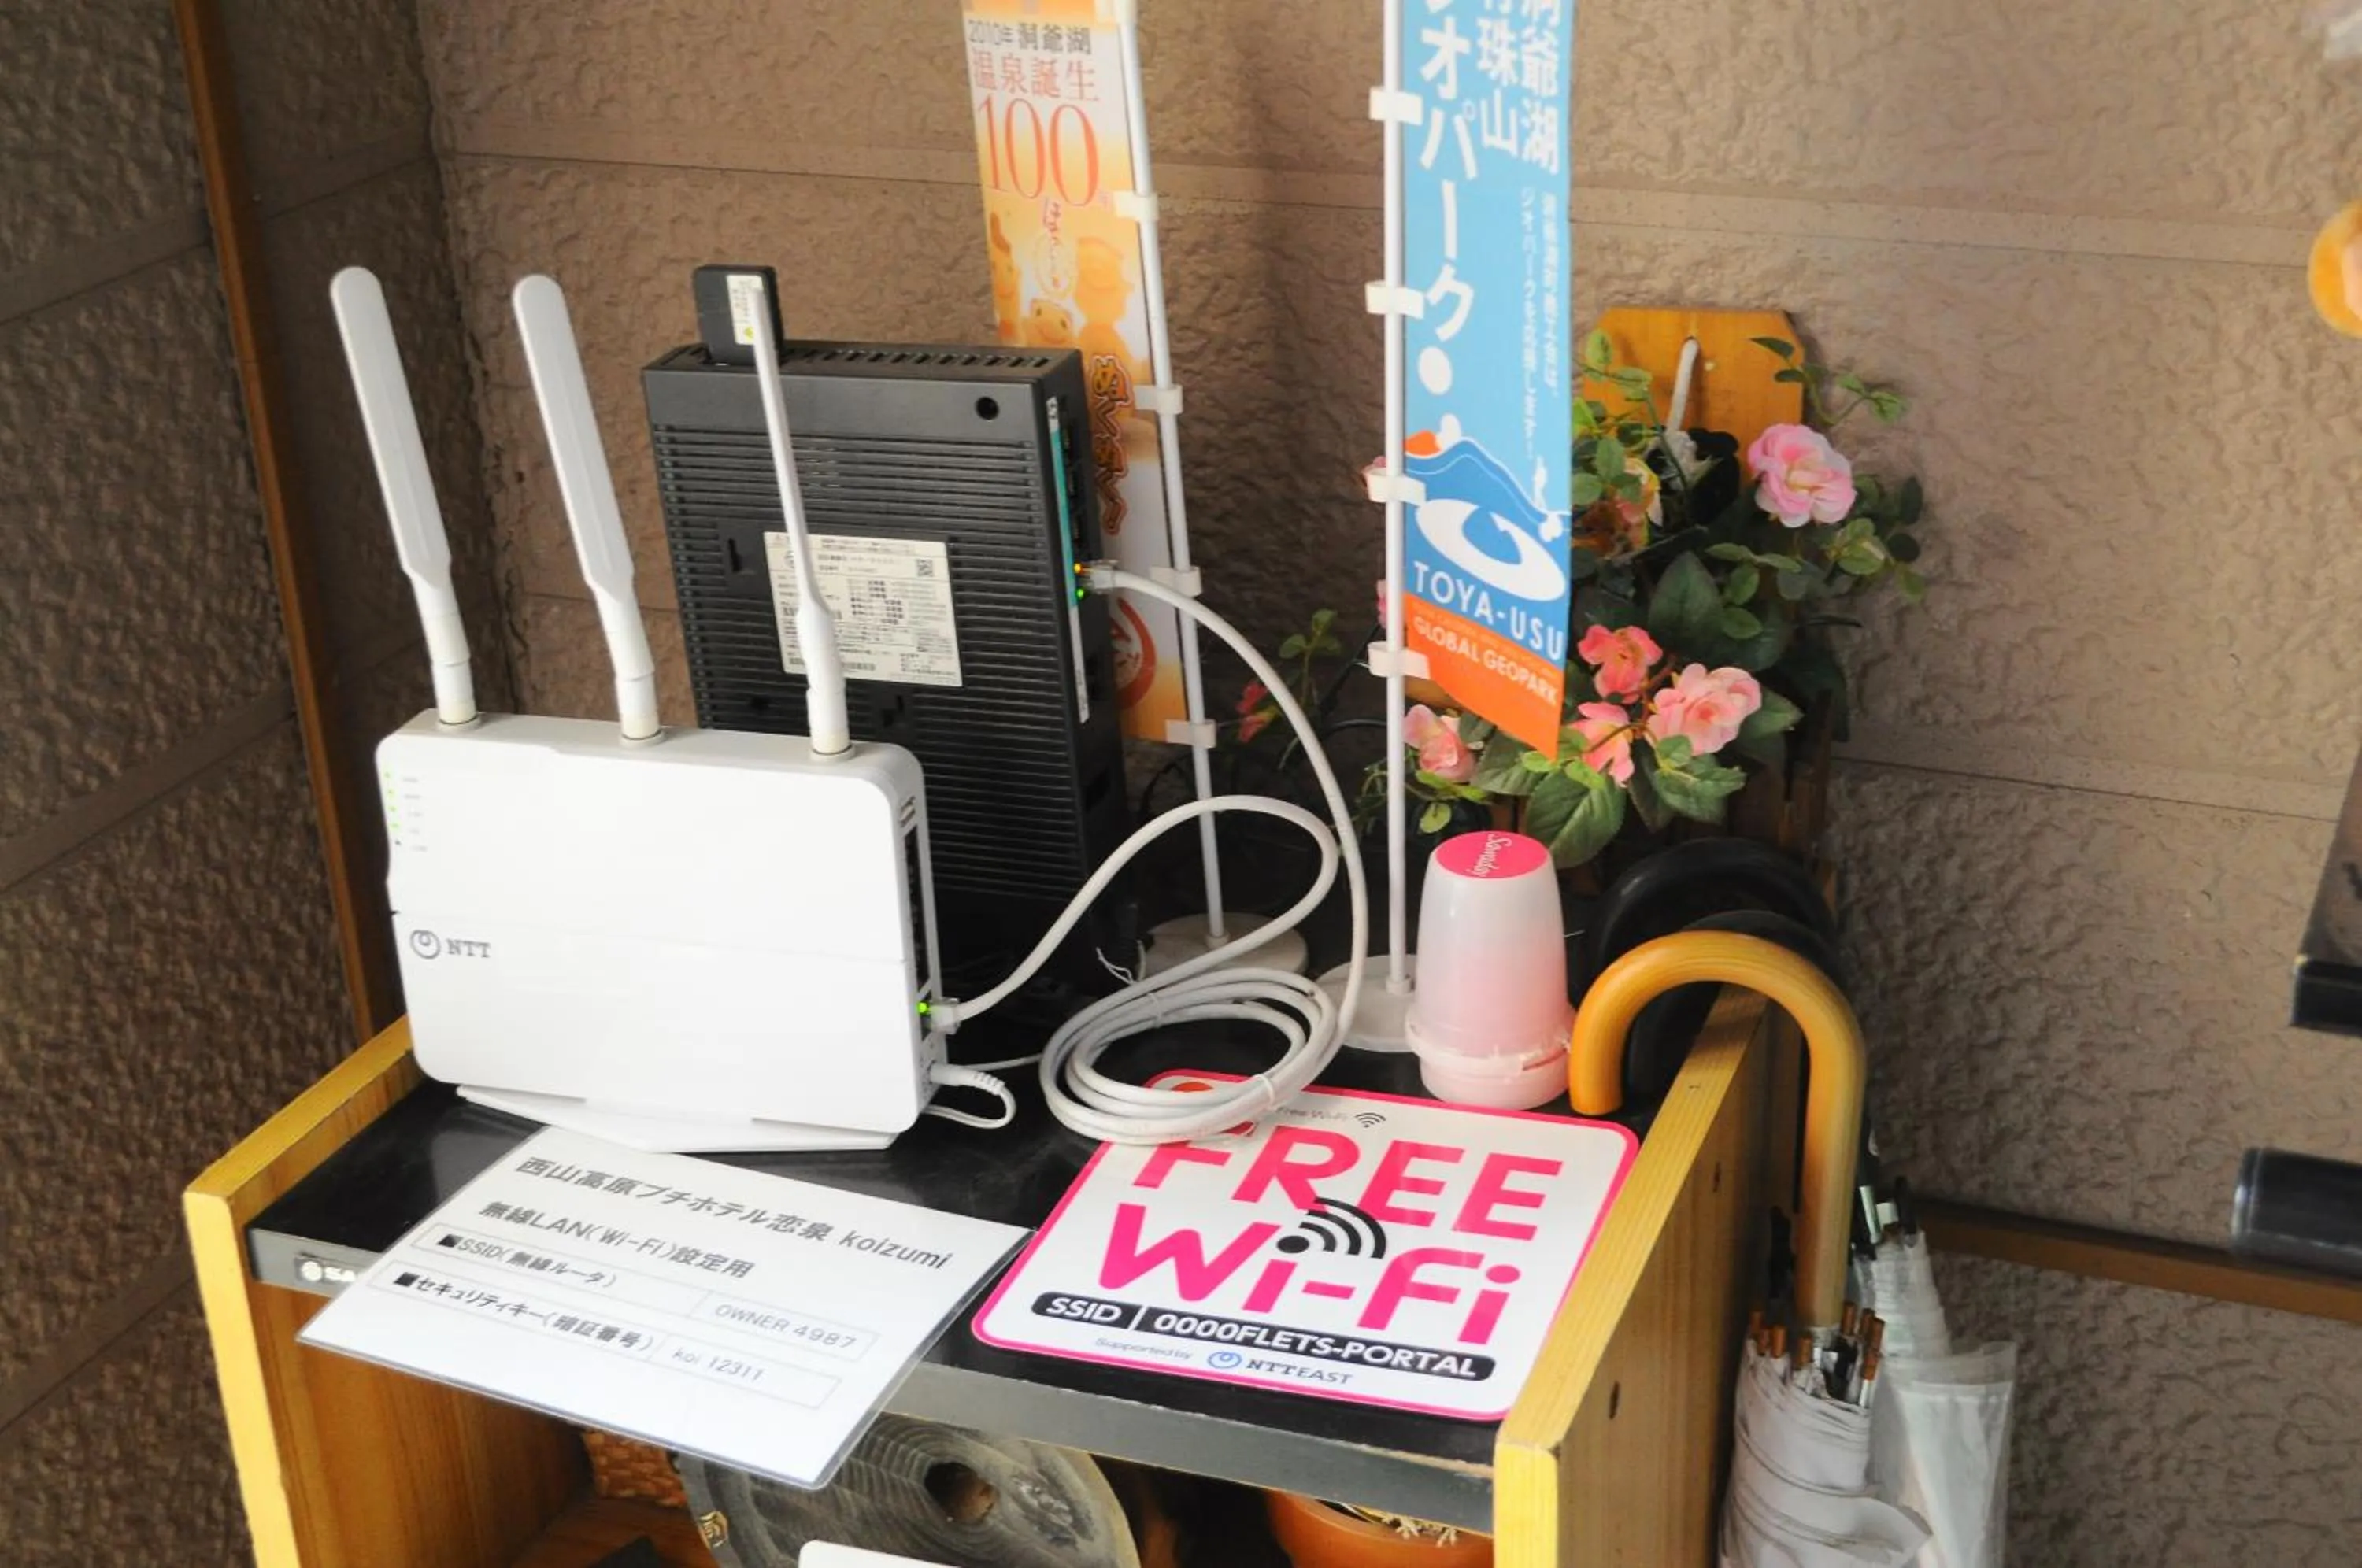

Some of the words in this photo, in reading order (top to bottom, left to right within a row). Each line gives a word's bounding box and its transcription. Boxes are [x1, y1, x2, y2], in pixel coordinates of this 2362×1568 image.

[1476, 0, 1518, 157] 珠山
[978, 94, 1100, 207] 100
[1420, 0, 1478, 342] オパーク
[1413, 616, 1480, 663] GLOBAL
[1483, 649, 1558, 706] GEOPARK
[1414, 560, 1564, 661] TOYA-USU
[446, 938, 491, 959] NTT
[516, 1156, 835, 1242] 西山高原プチホテル恋泉
[839, 1230, 953, 1270] koizumi
[1132, 1121, 1564, 1241] FREE
[1099, 1204, 1521, 1345] Wi-Fi
[709, 1355, 765, 1381] 12311
[715, 1304, 790, 1332] OWNER
[793, 1325, 857, 1348] 4987
[1046, 1296, 1122, 1322] SSID
[1153, 1313, 1477, 1379] 0000FLETS-PORTAL
[1095, 1337, 1173, 1356] Supported
